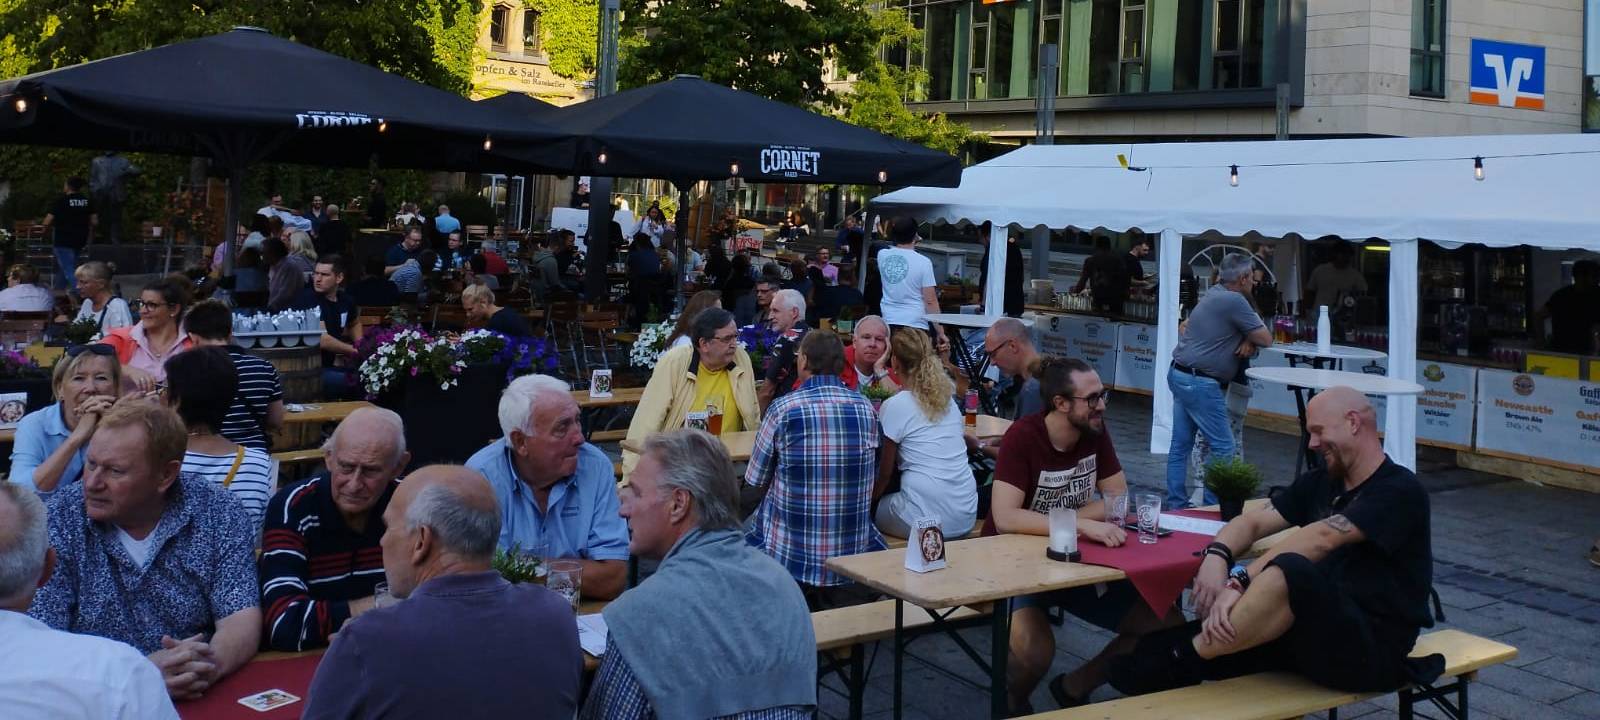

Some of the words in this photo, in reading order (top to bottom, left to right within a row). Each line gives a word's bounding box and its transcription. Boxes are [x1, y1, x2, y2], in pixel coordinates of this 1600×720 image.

[475, 64, 505, 75] opfen
[508, 66, 517, 76] &
[520, 68, 541, 79] Salz
[760, 148, 820, 176] CORNET
[1579, 386, 1600, 399] Gaff
[1495, 398, 1554, 415] Newcastle
[1505, 411, 1530, 421] Brown
[1531, 415, 1543, 424] Ale
[1576, 410, 1600, 421] Gaf
[1582, 423, 1600, 432] Köls
[1072, 476, 1091, 493] FREE
